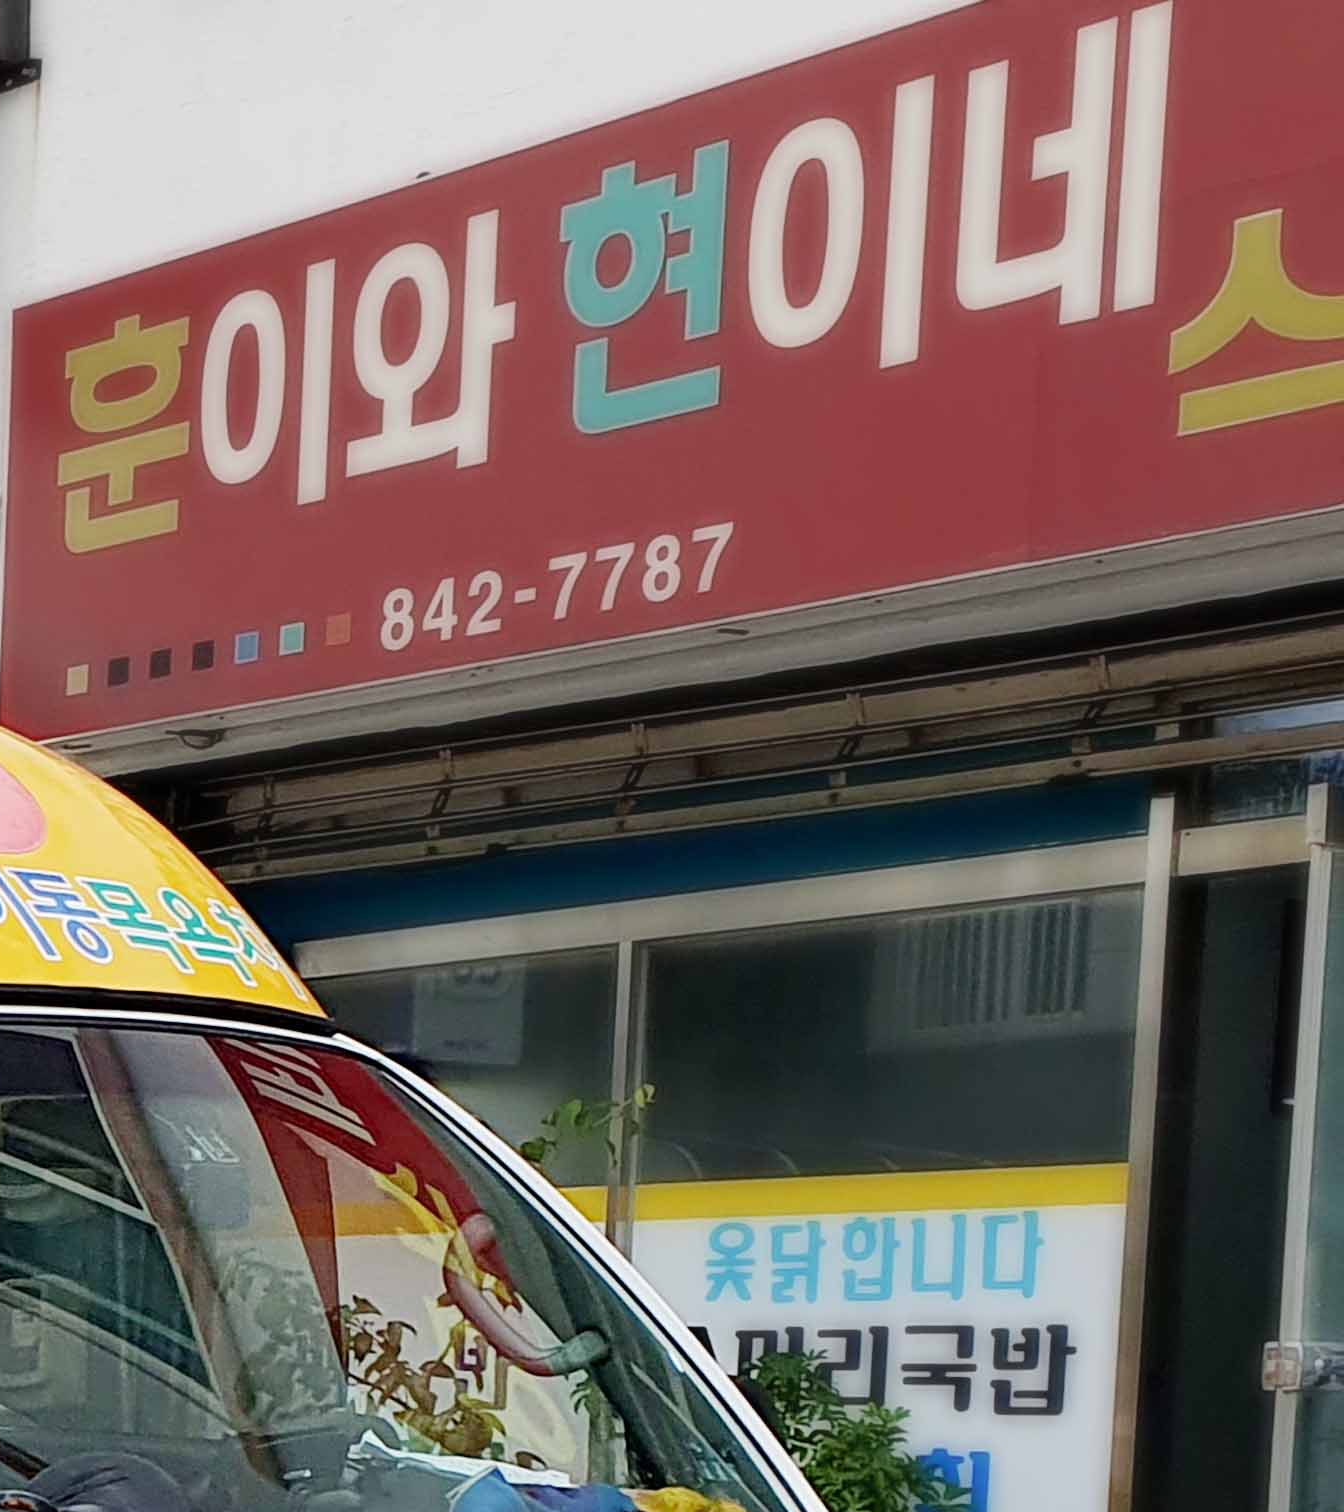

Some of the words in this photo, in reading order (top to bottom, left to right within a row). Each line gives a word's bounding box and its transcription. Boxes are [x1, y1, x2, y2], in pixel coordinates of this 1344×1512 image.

[57, 208, 517, 555] 훈이와
[559, 0, 1174, 435] 현이네
[379, 521, 735, 652] 842-7787
